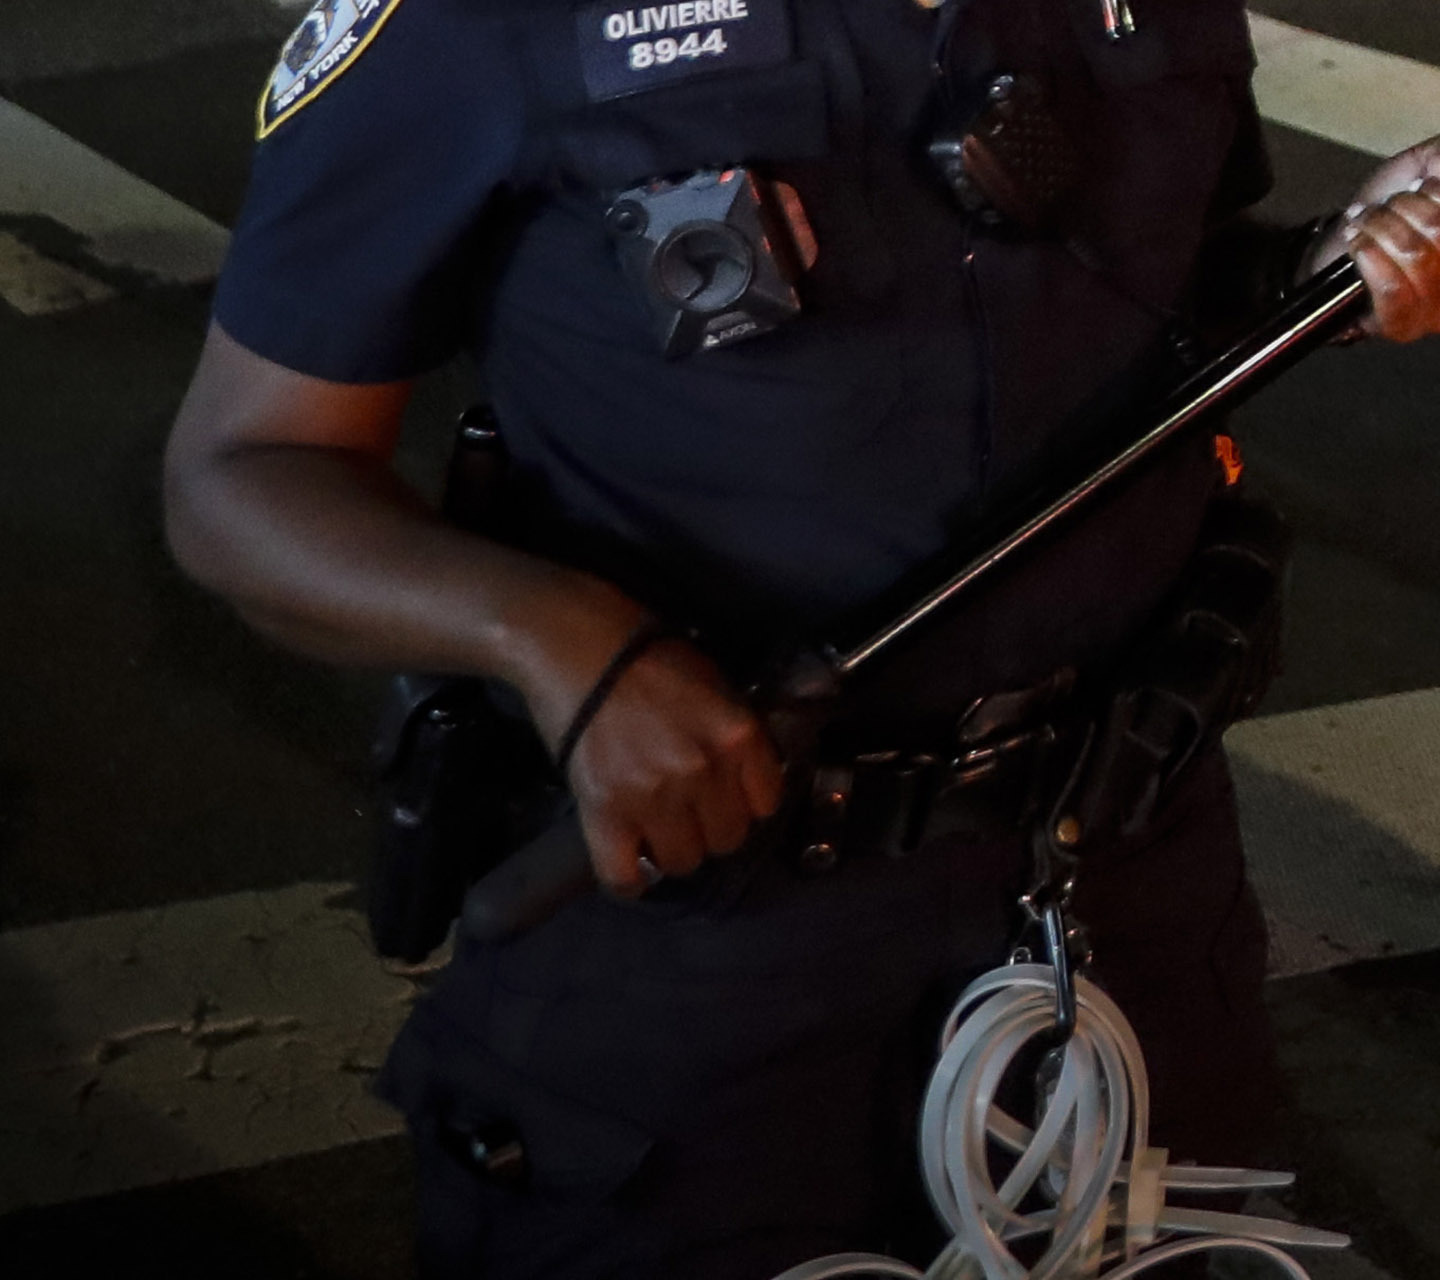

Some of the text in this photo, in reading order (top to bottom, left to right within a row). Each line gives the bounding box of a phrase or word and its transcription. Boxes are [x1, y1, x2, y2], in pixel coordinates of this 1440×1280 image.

[275, 30, 359, 112] NEW YORK
[629, 28, 728, 71] 8944
